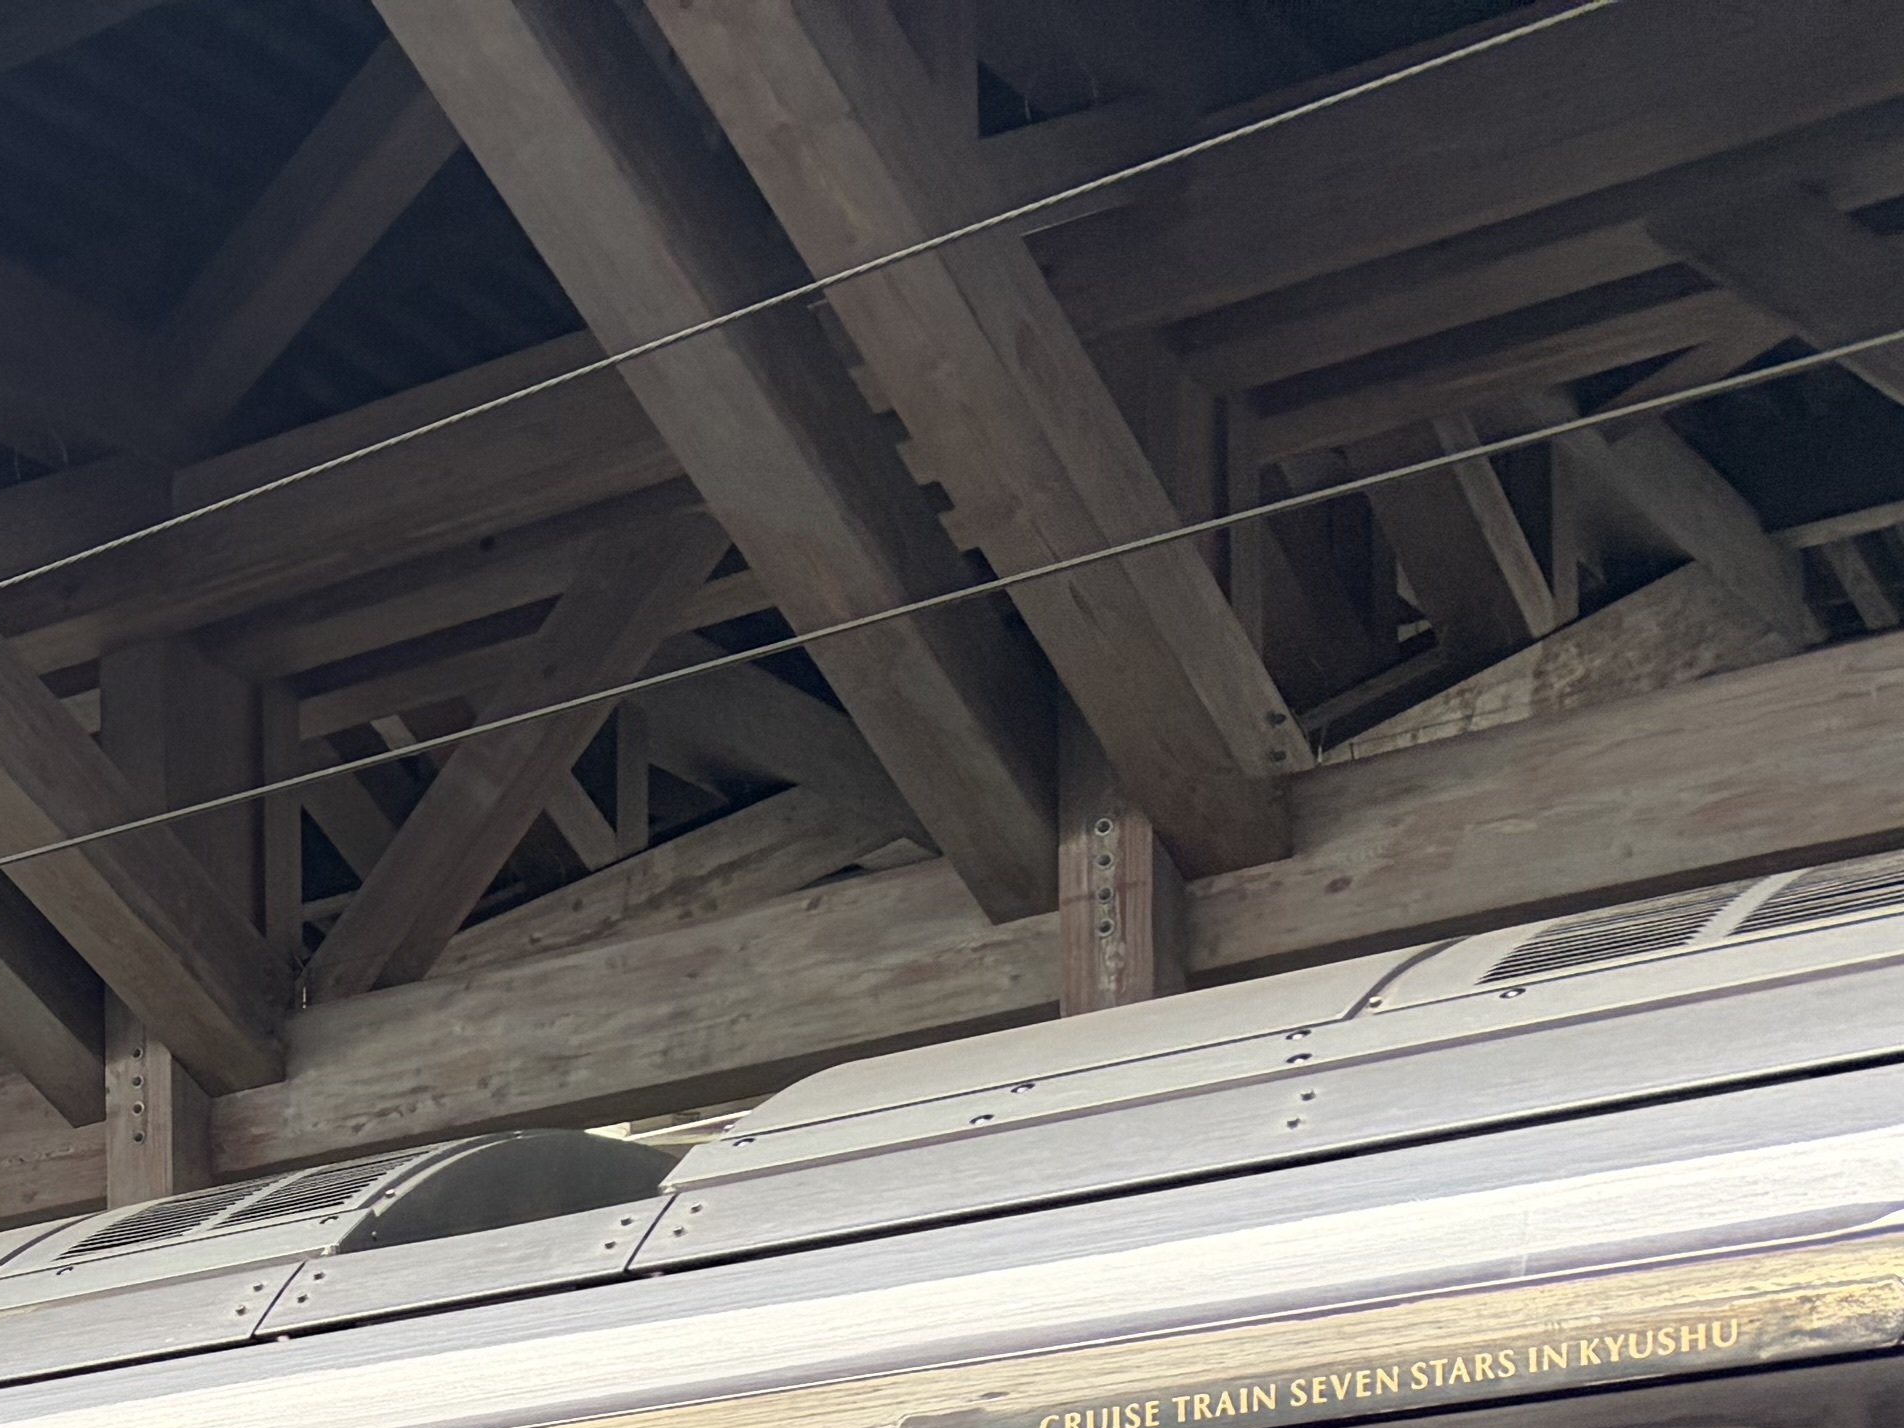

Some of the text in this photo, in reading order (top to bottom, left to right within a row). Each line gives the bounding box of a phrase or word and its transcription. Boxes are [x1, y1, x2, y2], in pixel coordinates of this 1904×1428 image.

[1172, 1383, 1277, 1427] TRAIN
[1290, 1365, 1399, 1407] SEVEN
[1410, 1347, 1516, 1390] STARS
[1529, 1340, 1570, 1373] IN
[1579, 1318, 1741, 1365] KYUSHU
